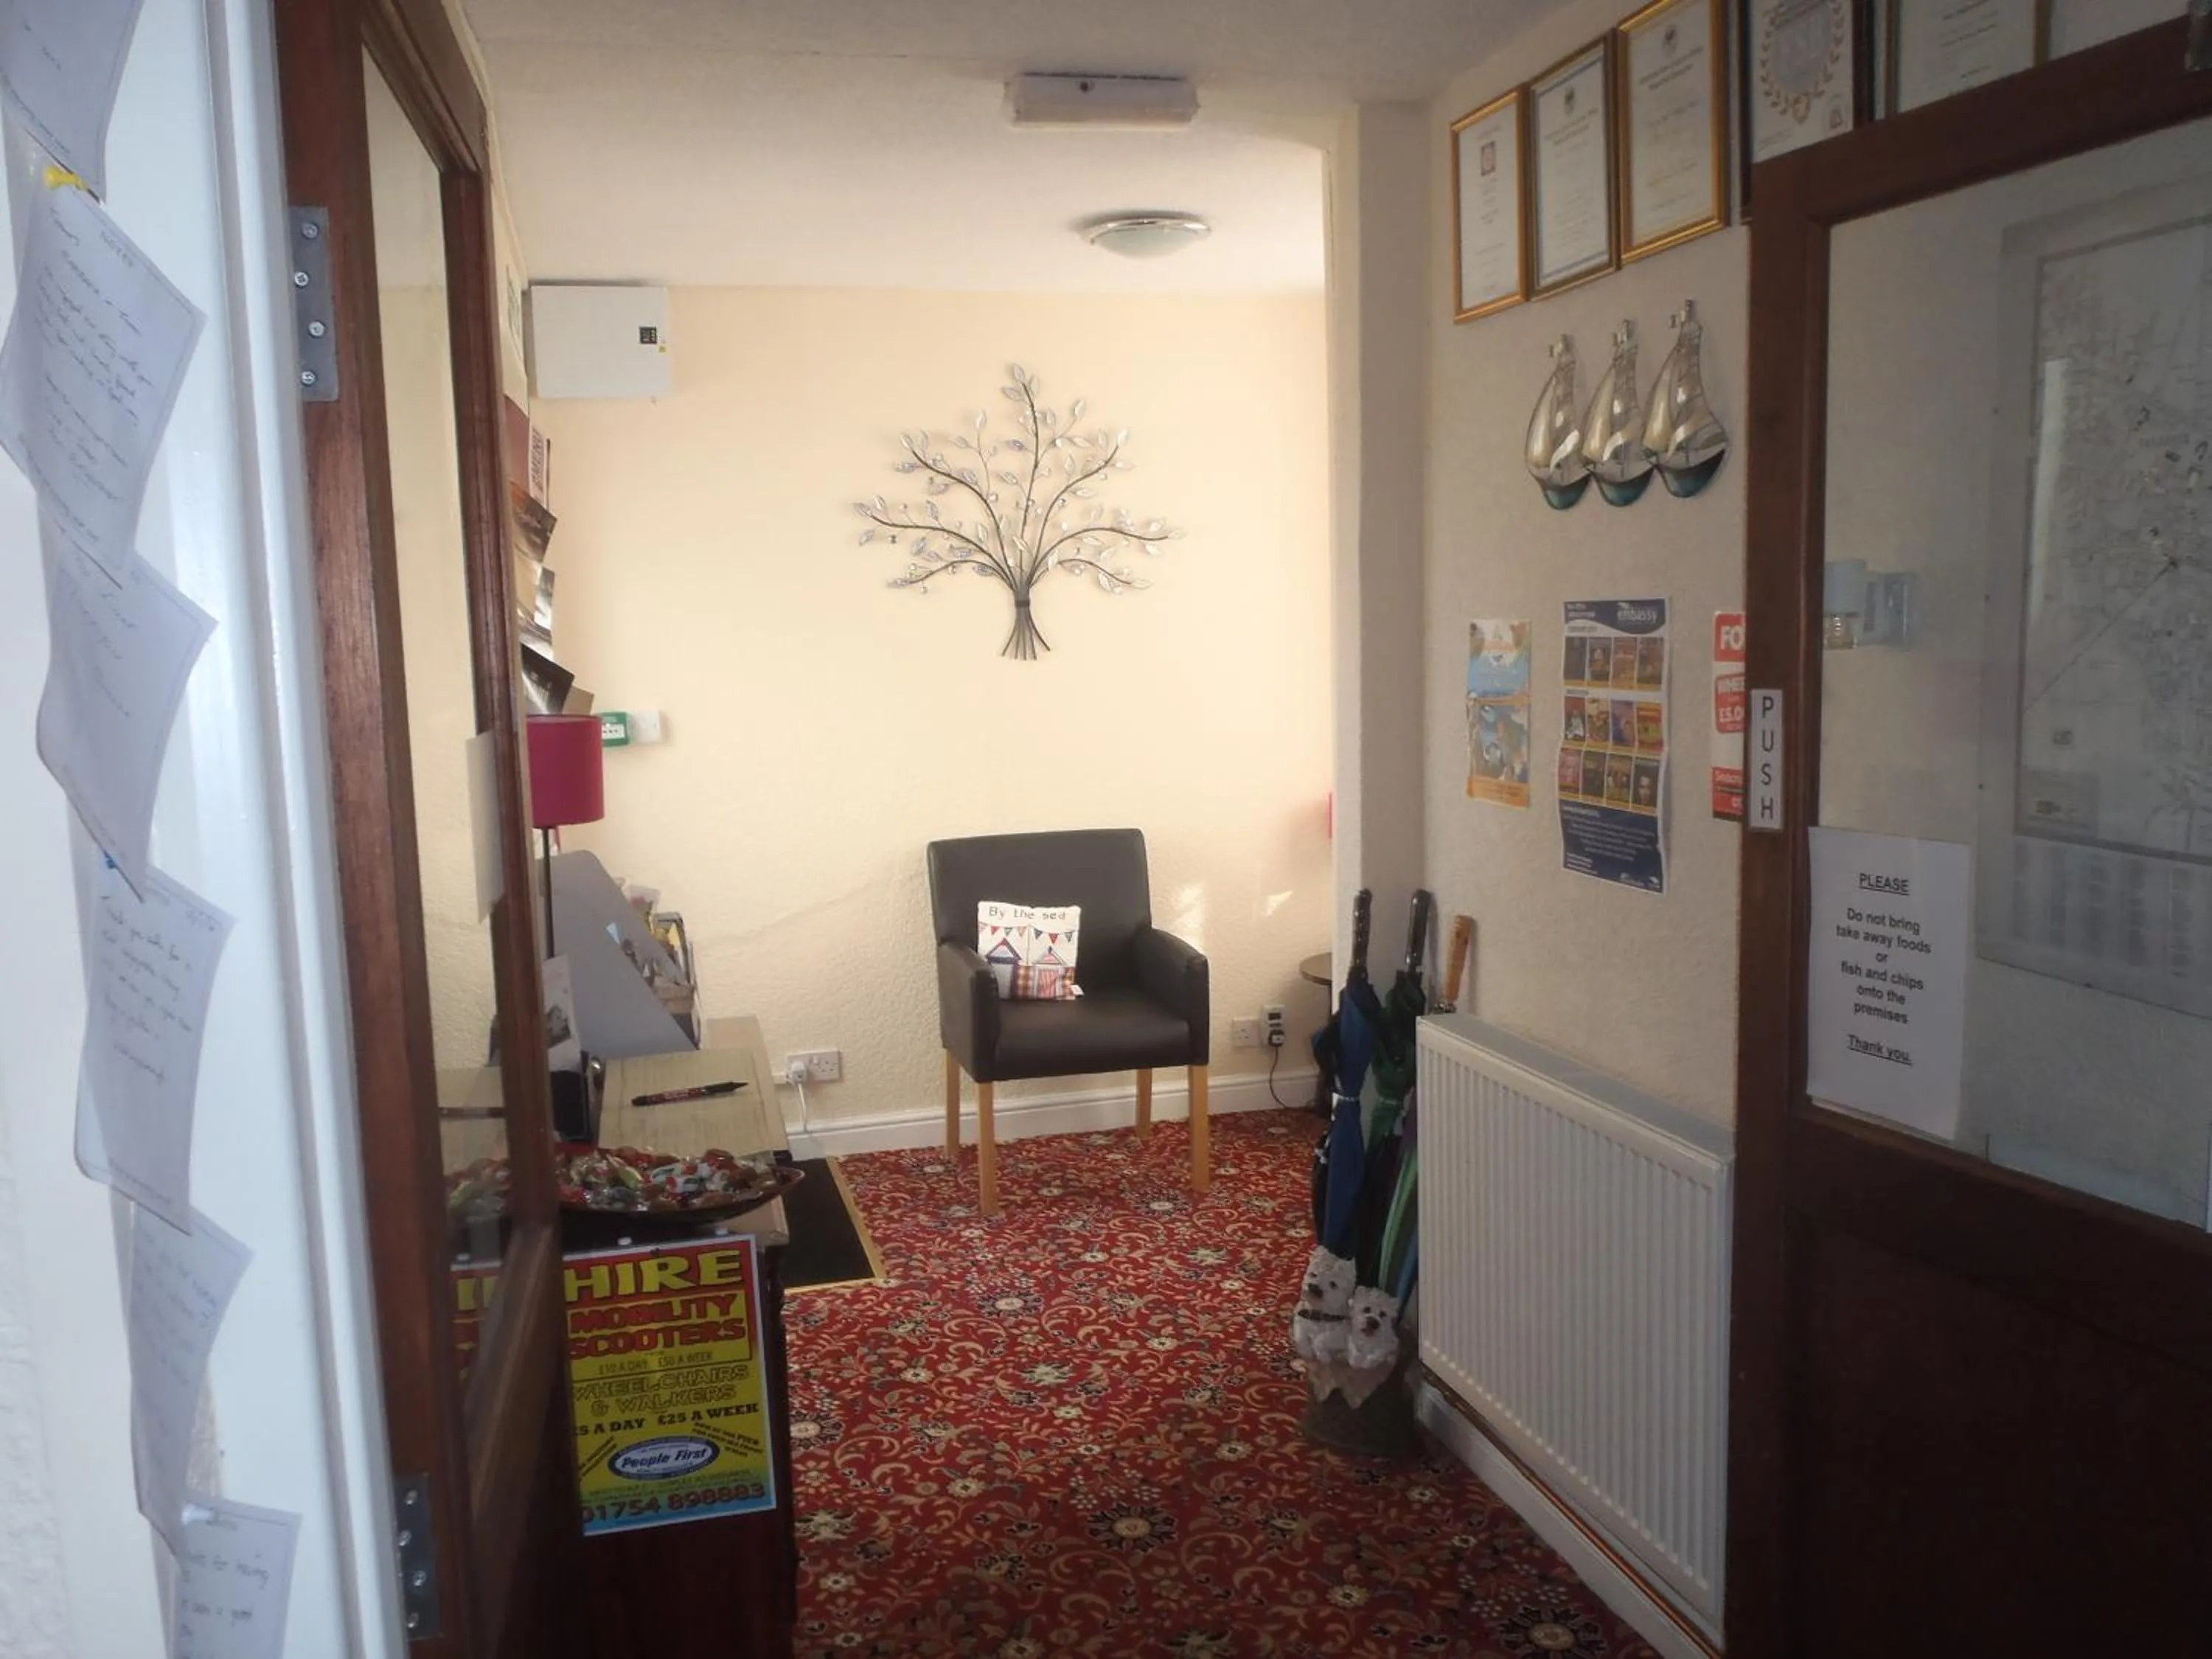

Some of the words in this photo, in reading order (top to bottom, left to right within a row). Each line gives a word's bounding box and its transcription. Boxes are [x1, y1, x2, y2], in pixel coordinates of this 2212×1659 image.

[1761, 696, 1774, 819] PUSH
[1859, 873, 1910, 894] PLEASE
[989, 906, 1004, 920] By
[1014, 908, 1034, 919] the
[1847, 908, 1863, 921] Do
[1867, 912, 1886, 925] not
[1889, 916, 1920, 936] bring
[1836, 925, 1860, 940] take
[1863, 931, 1893, 949] away
[1897, 936, 1932, 954] foods
[1876, 953, 1888, 962] or
[1841, 961, 1862, 978] fish
[1865, 968, 1887, 982] and
[1891, 973, 1924, 990] chips
[1857, 984, 1883, 998] onto
[1887, 990, 1906, 1005] the
[1848, 1034, 1883, 1054] Thank
[563, 1250, 742, 1302] HIRE
[570, 1293, 739, 1334] MOBILITY
[568, 1318, 746, 1360] SCOOTERS
[616, 1383, 737, 1414] WALKERS
[594, 1422, 606, 1435] A
[609, 1417, 647, 1433] DAY
[657, 1412, 686, 1426] £25
[690, 1410, 704, 1422] A
[706, 1403, 759, 1419] WEEK
[621, 1452, 670, 1470] People
[673, 1447, 707, 1463] First
